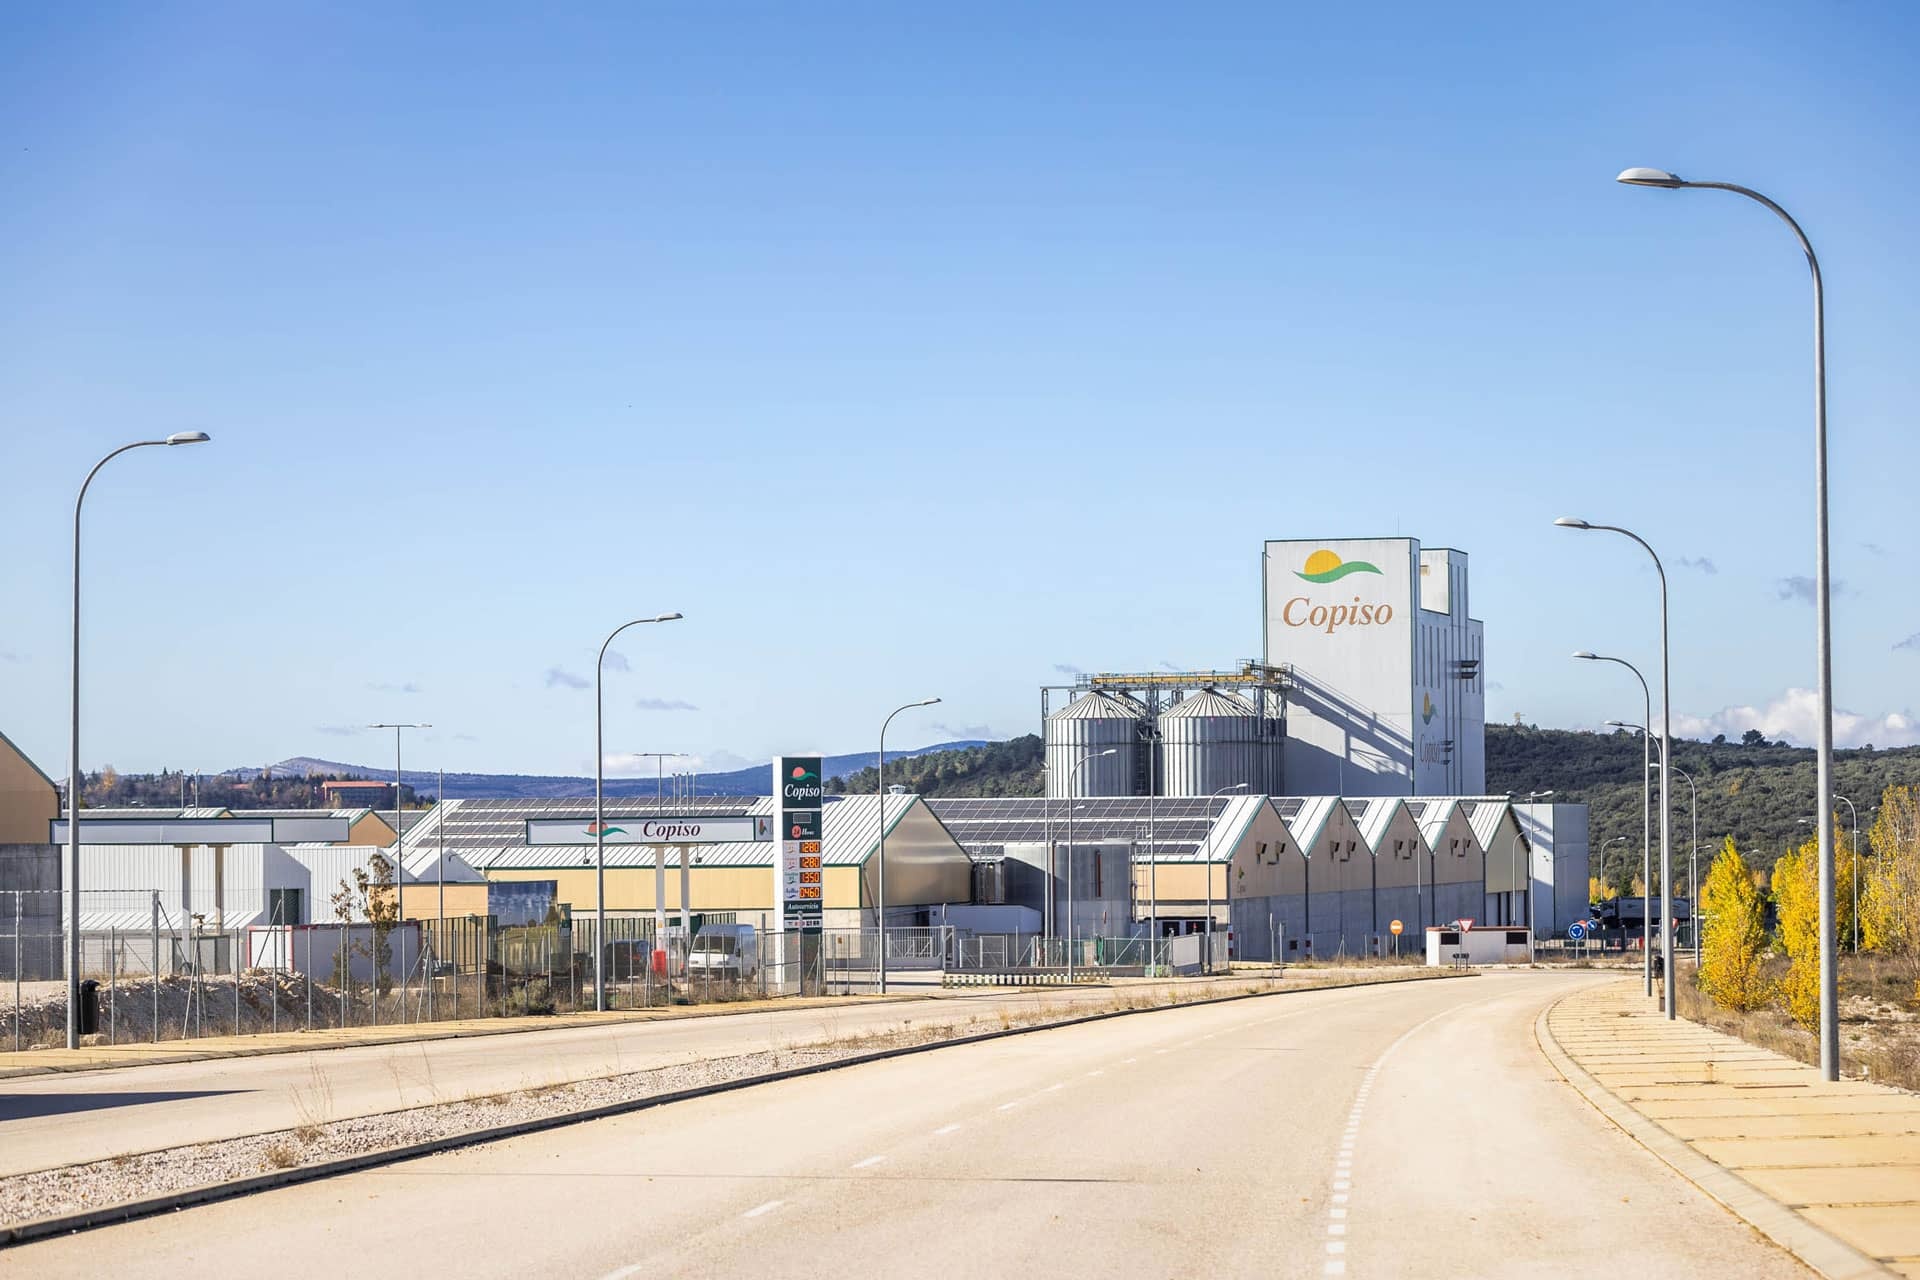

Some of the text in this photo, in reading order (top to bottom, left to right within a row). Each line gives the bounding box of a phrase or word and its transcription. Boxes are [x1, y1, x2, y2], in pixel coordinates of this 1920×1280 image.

[1283, 596, 1393, 634] Copiso
[784, 783, 820, 801] Copiso
[642, 820, 701, 841] Copiso
[799, 887, 820, 898] 0460
